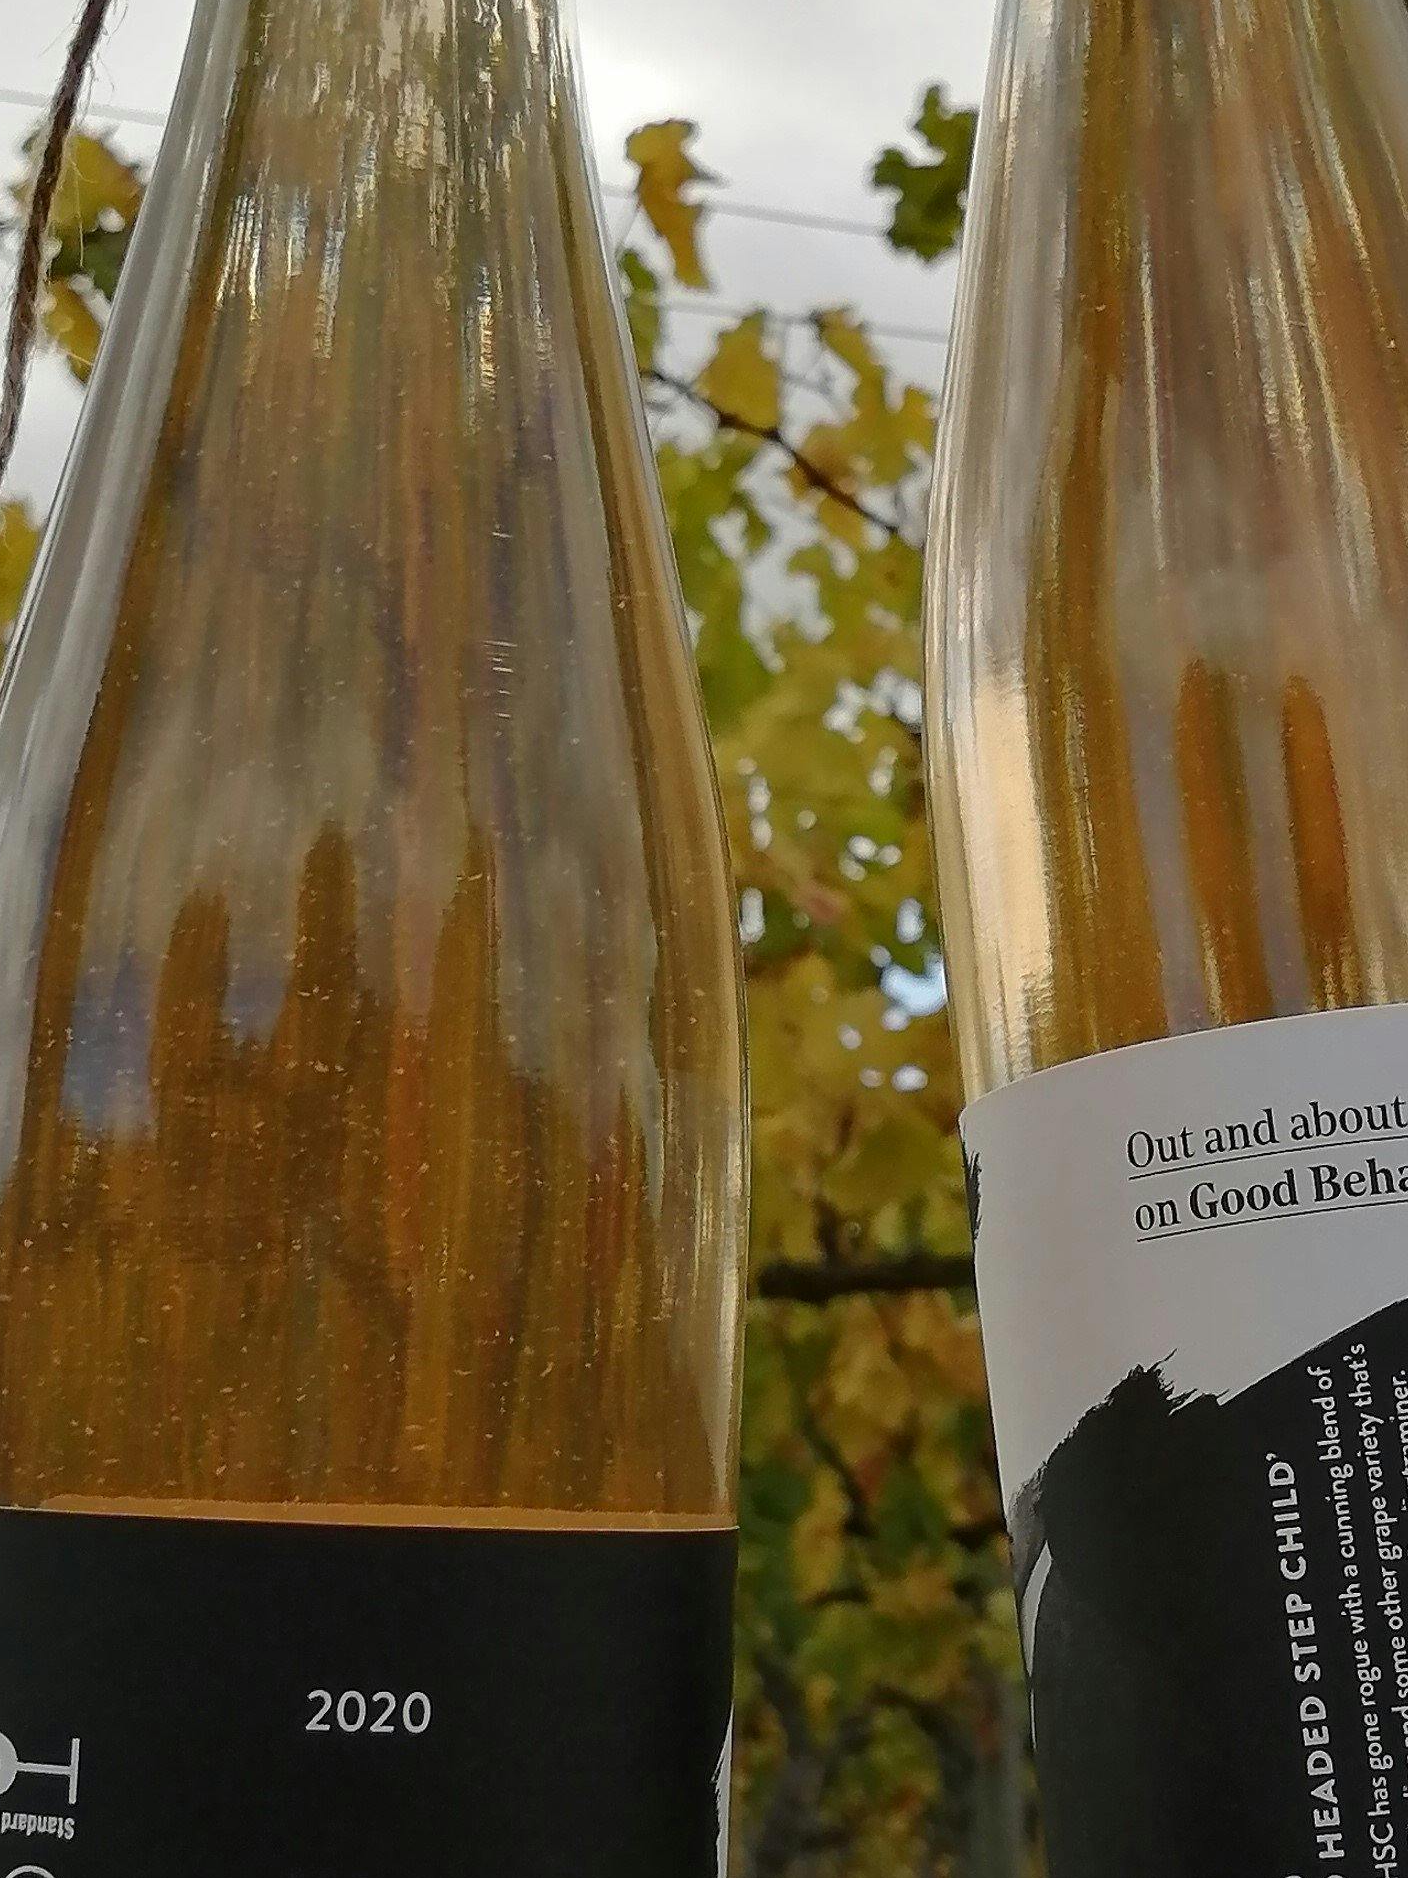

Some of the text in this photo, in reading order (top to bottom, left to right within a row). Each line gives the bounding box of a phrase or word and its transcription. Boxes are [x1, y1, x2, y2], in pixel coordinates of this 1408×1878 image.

[1126, 1095, 1408, 1168] Out and about
[1135, 1199, 1182, 1232] on
[1189, 1169, 1300, 1221] Good
[1306, 1365, 1333, 1391] of
[1342, 1343, 1373, 1408] that's
[1310, 1396, 1342, 1461] blend
[1354, 1412, 1385, 1492] variety
[1324, 1463, 1356, 1559] cunning
[1371, 1496, 1403, 1561] grape
[1343, 1564, 1359, 1578] a
[1376, 1565, 1404, 1631] other
[1285, 1593, 1321, 1683] STEP
[1337, 1582, 1367, 1635] with
[1353, 1638, 1382, 1706] rogue
[304, 1689, 432, 1734] 2020
[1363, 1712, 1394, 1771] gone
[1299, 1695, 1345, 1860] HEADED
[1366, 1776, 1391, 1817] has
